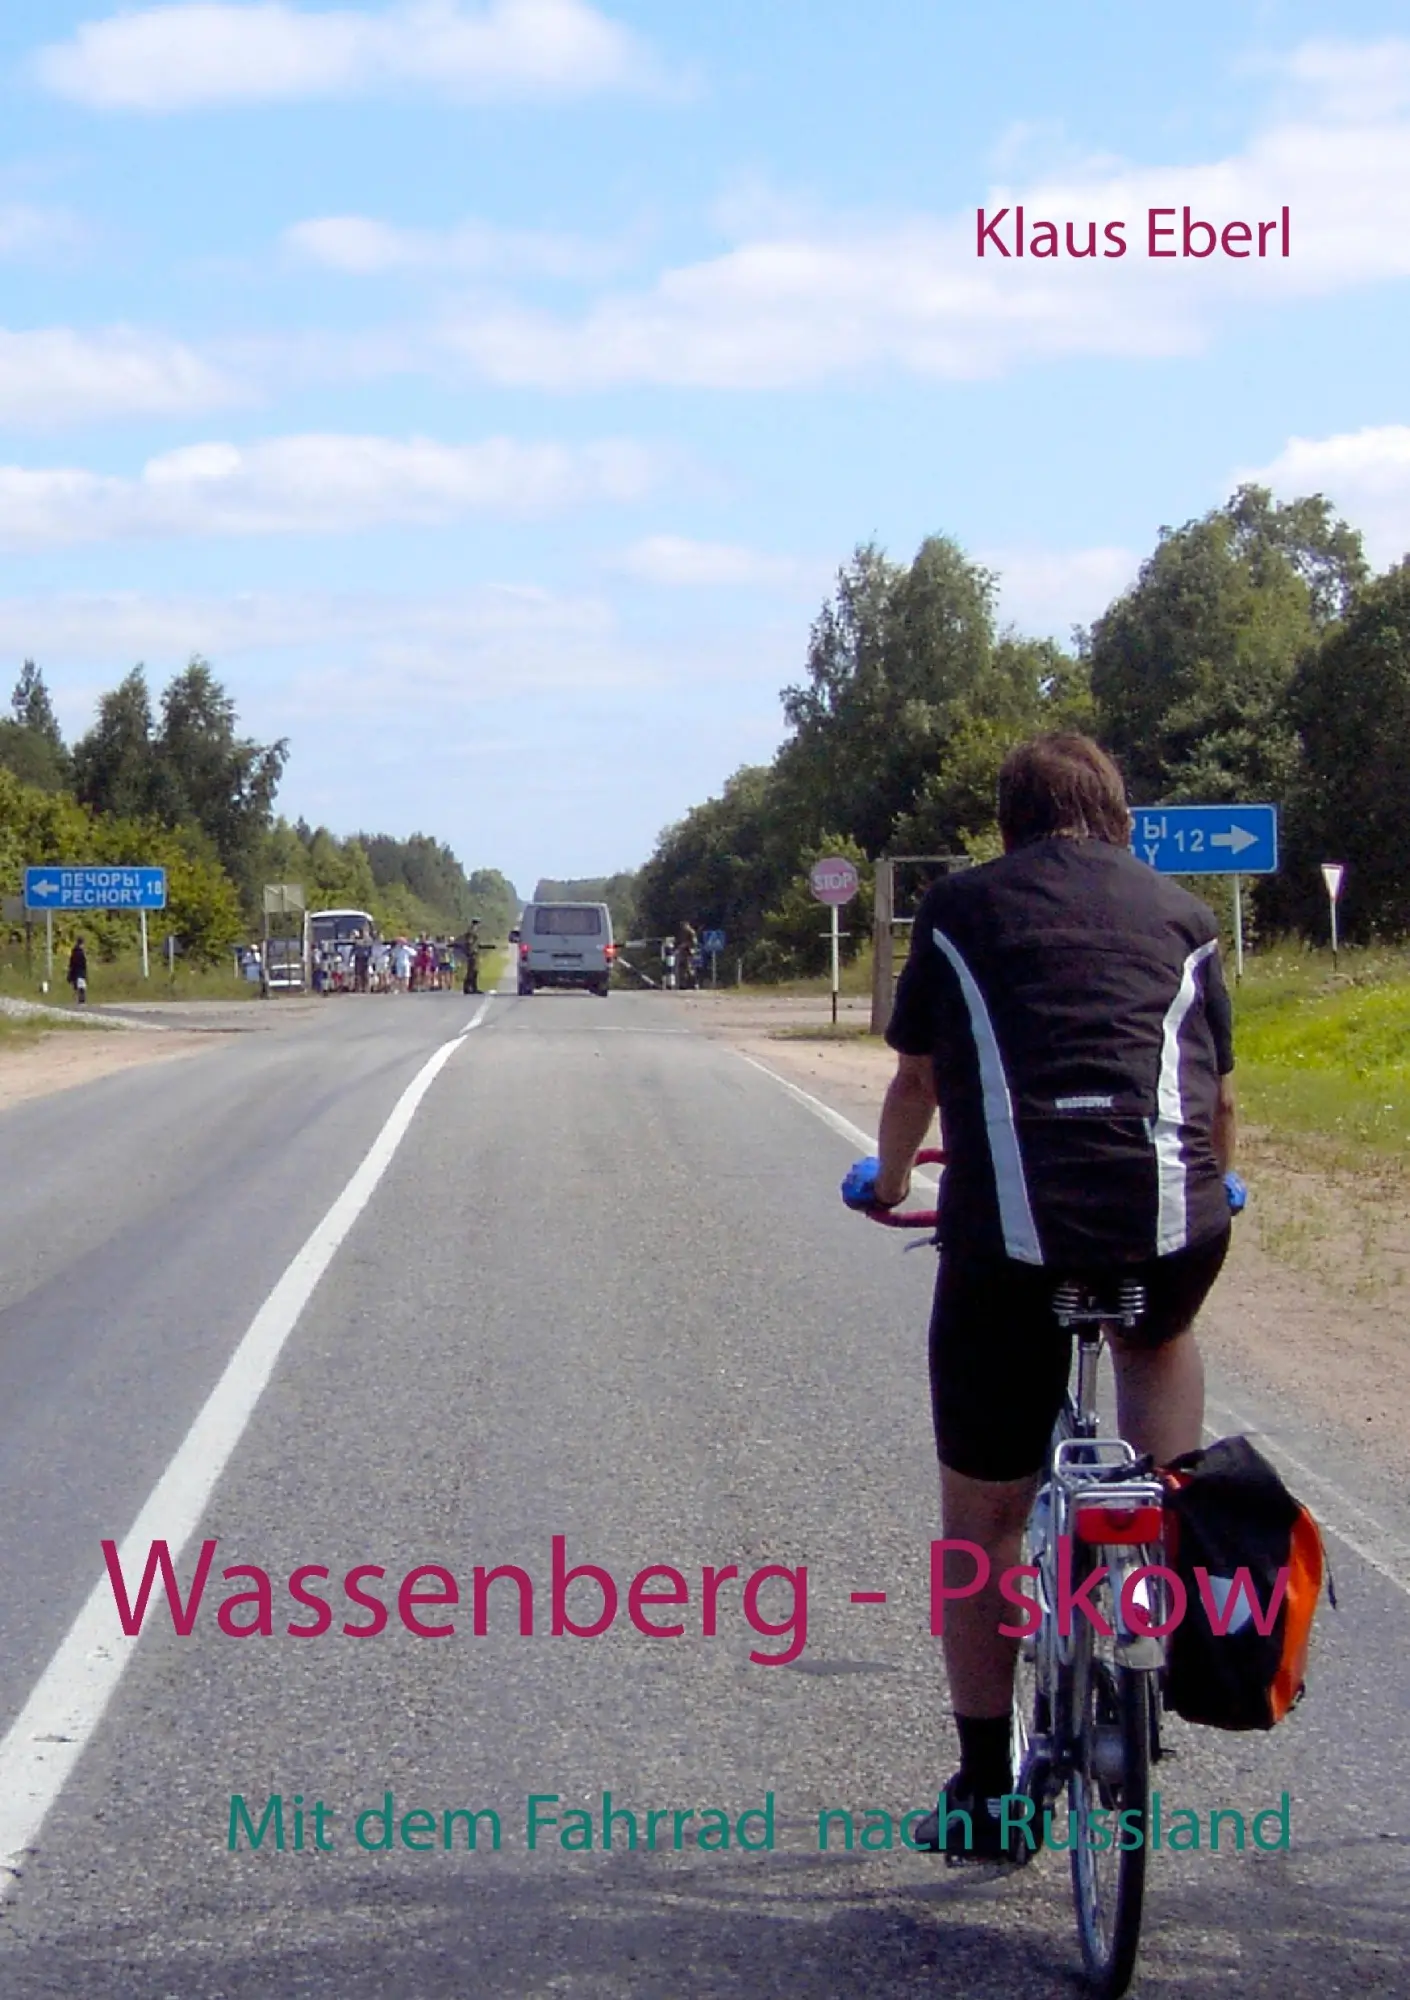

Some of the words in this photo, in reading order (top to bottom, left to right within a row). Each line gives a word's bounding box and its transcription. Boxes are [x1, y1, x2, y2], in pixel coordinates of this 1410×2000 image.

[1173, 828, 1205, 852] 12
[61, 872, 140, 887] ПЕЧОРЫ
[814, 872, 853, 891] STOP
[61, 889, 143, 904] PECHORY
